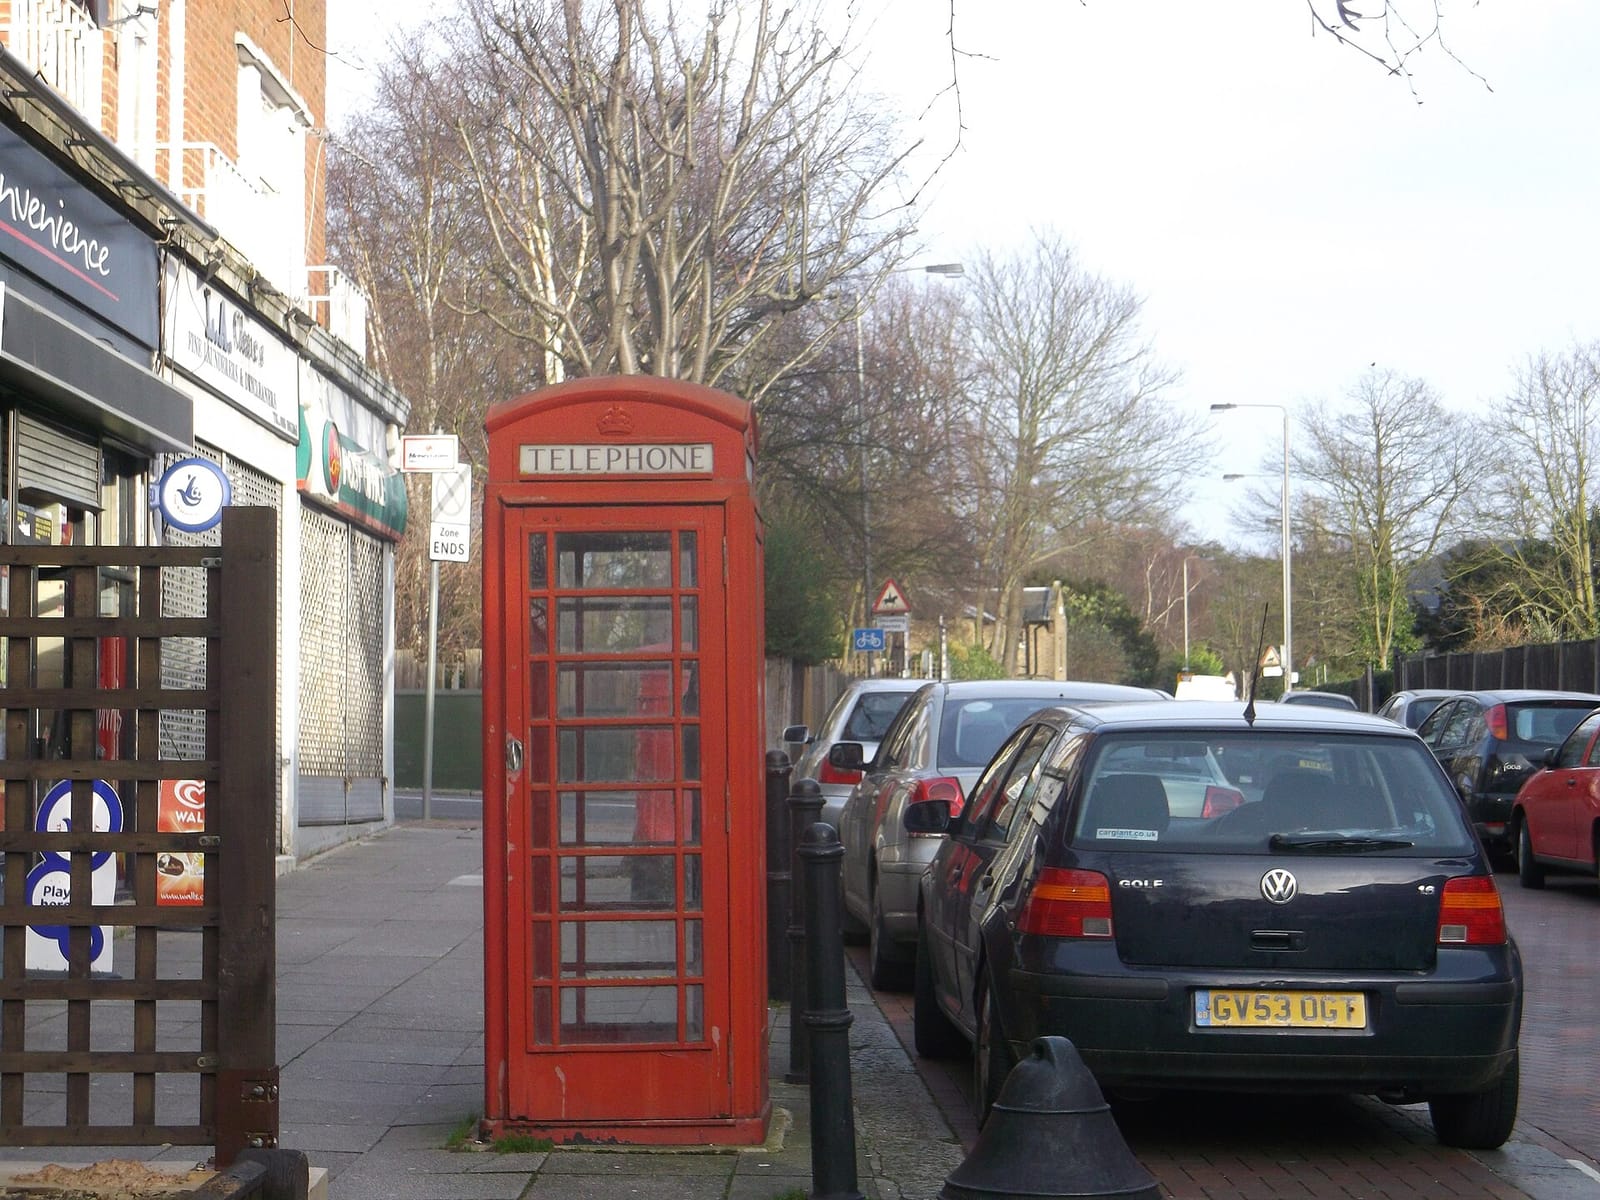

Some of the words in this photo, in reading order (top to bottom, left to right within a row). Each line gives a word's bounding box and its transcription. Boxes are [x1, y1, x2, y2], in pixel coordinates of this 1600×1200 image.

[528, 446, 705, 471] TELEPHONE
[440, 527, 459, 537] Zone
[433, 541, 465, 555] ENDS
[1119, 879, 1163, 889] GOLF
[43, 885, 71, 900] Play
[1213, 993, 1291, 1021] GV53
